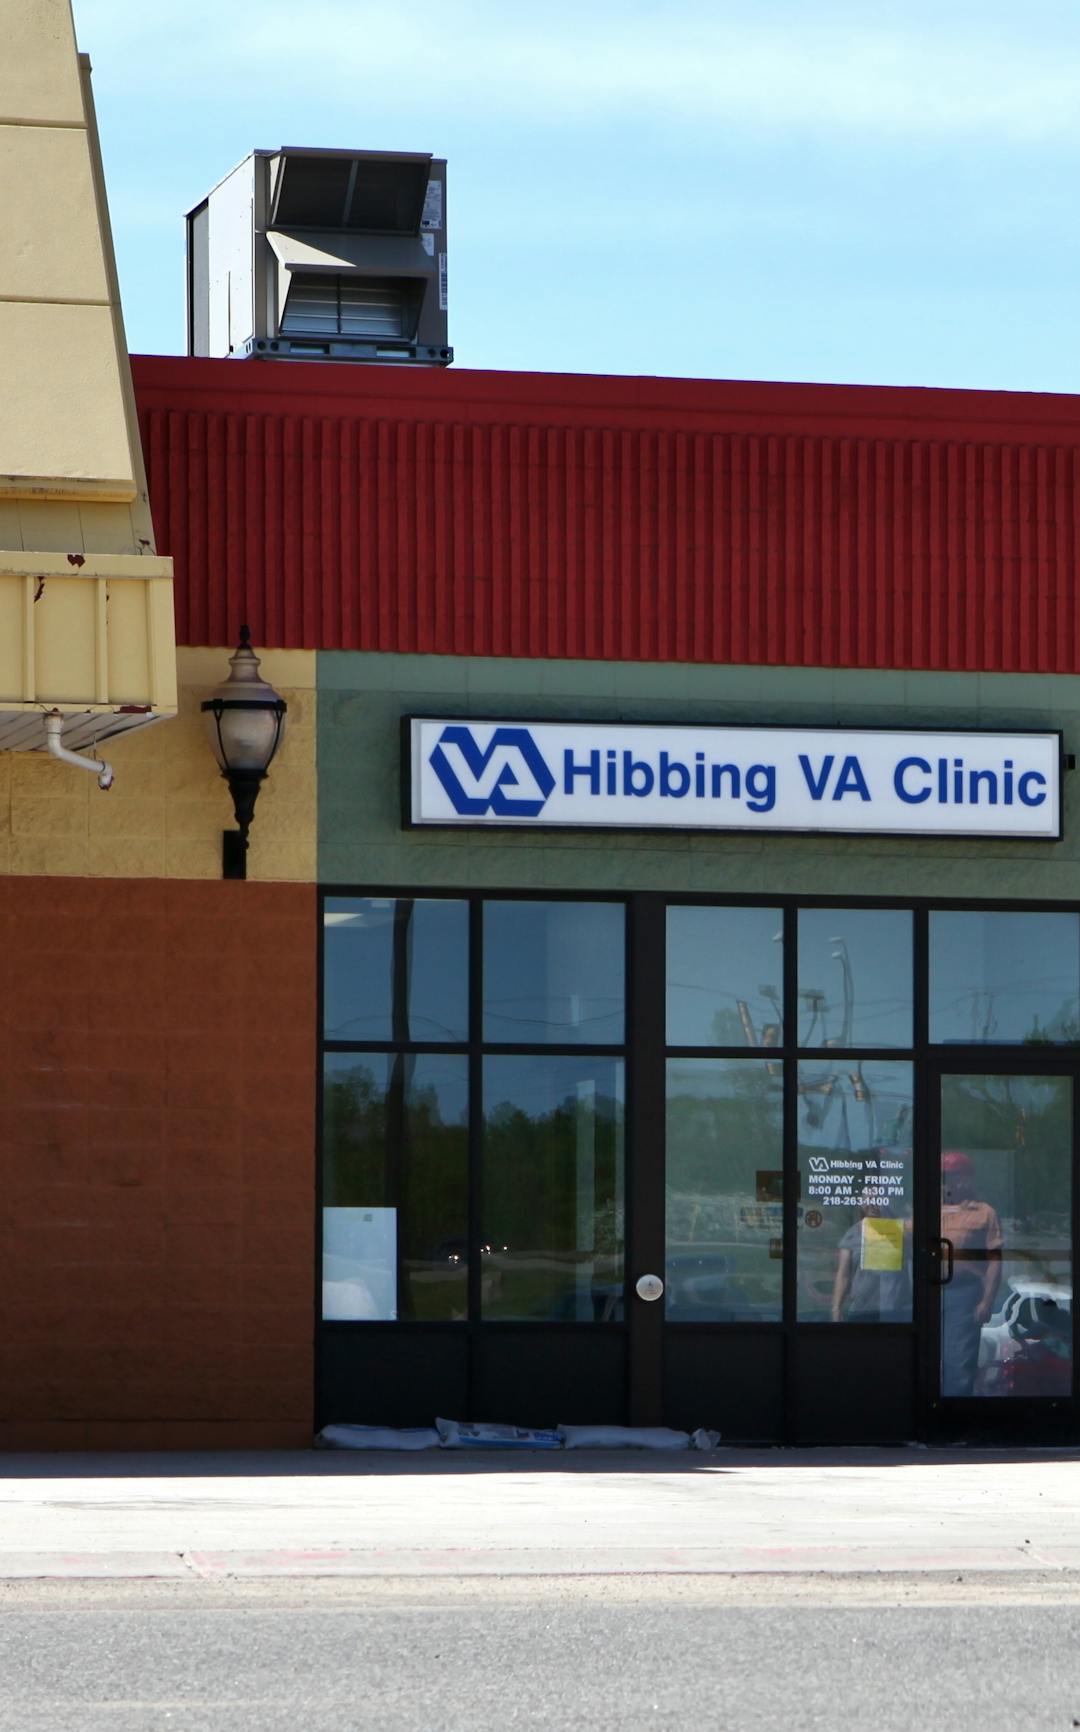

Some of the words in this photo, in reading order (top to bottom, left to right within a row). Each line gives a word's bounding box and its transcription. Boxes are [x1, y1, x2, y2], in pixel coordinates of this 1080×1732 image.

[428, 726, 556, 817] VA
[563, 748, 777, 813] Hibbing
[797, 754, 872, 802] VA
[893, 756, 1047, 807] Clinic
[830, 1160, 863, 1170] Hibbing
[865, 1160, 878, 1169] VA
[879, 1160, 904, 1169] Clinic
[808, 1175, 855, 1184] MONDAY
[864, 1175, 904, 1185] FRIDAY
[808, 1186, 831, 1195] 8:00
[834, 1186, 852, 1195] AM
[861, 1187, 885, 1195] 4:30
[887, 1187, 904, 1196] PM
[822, 1197, 889, 1206] 218-263-1400
